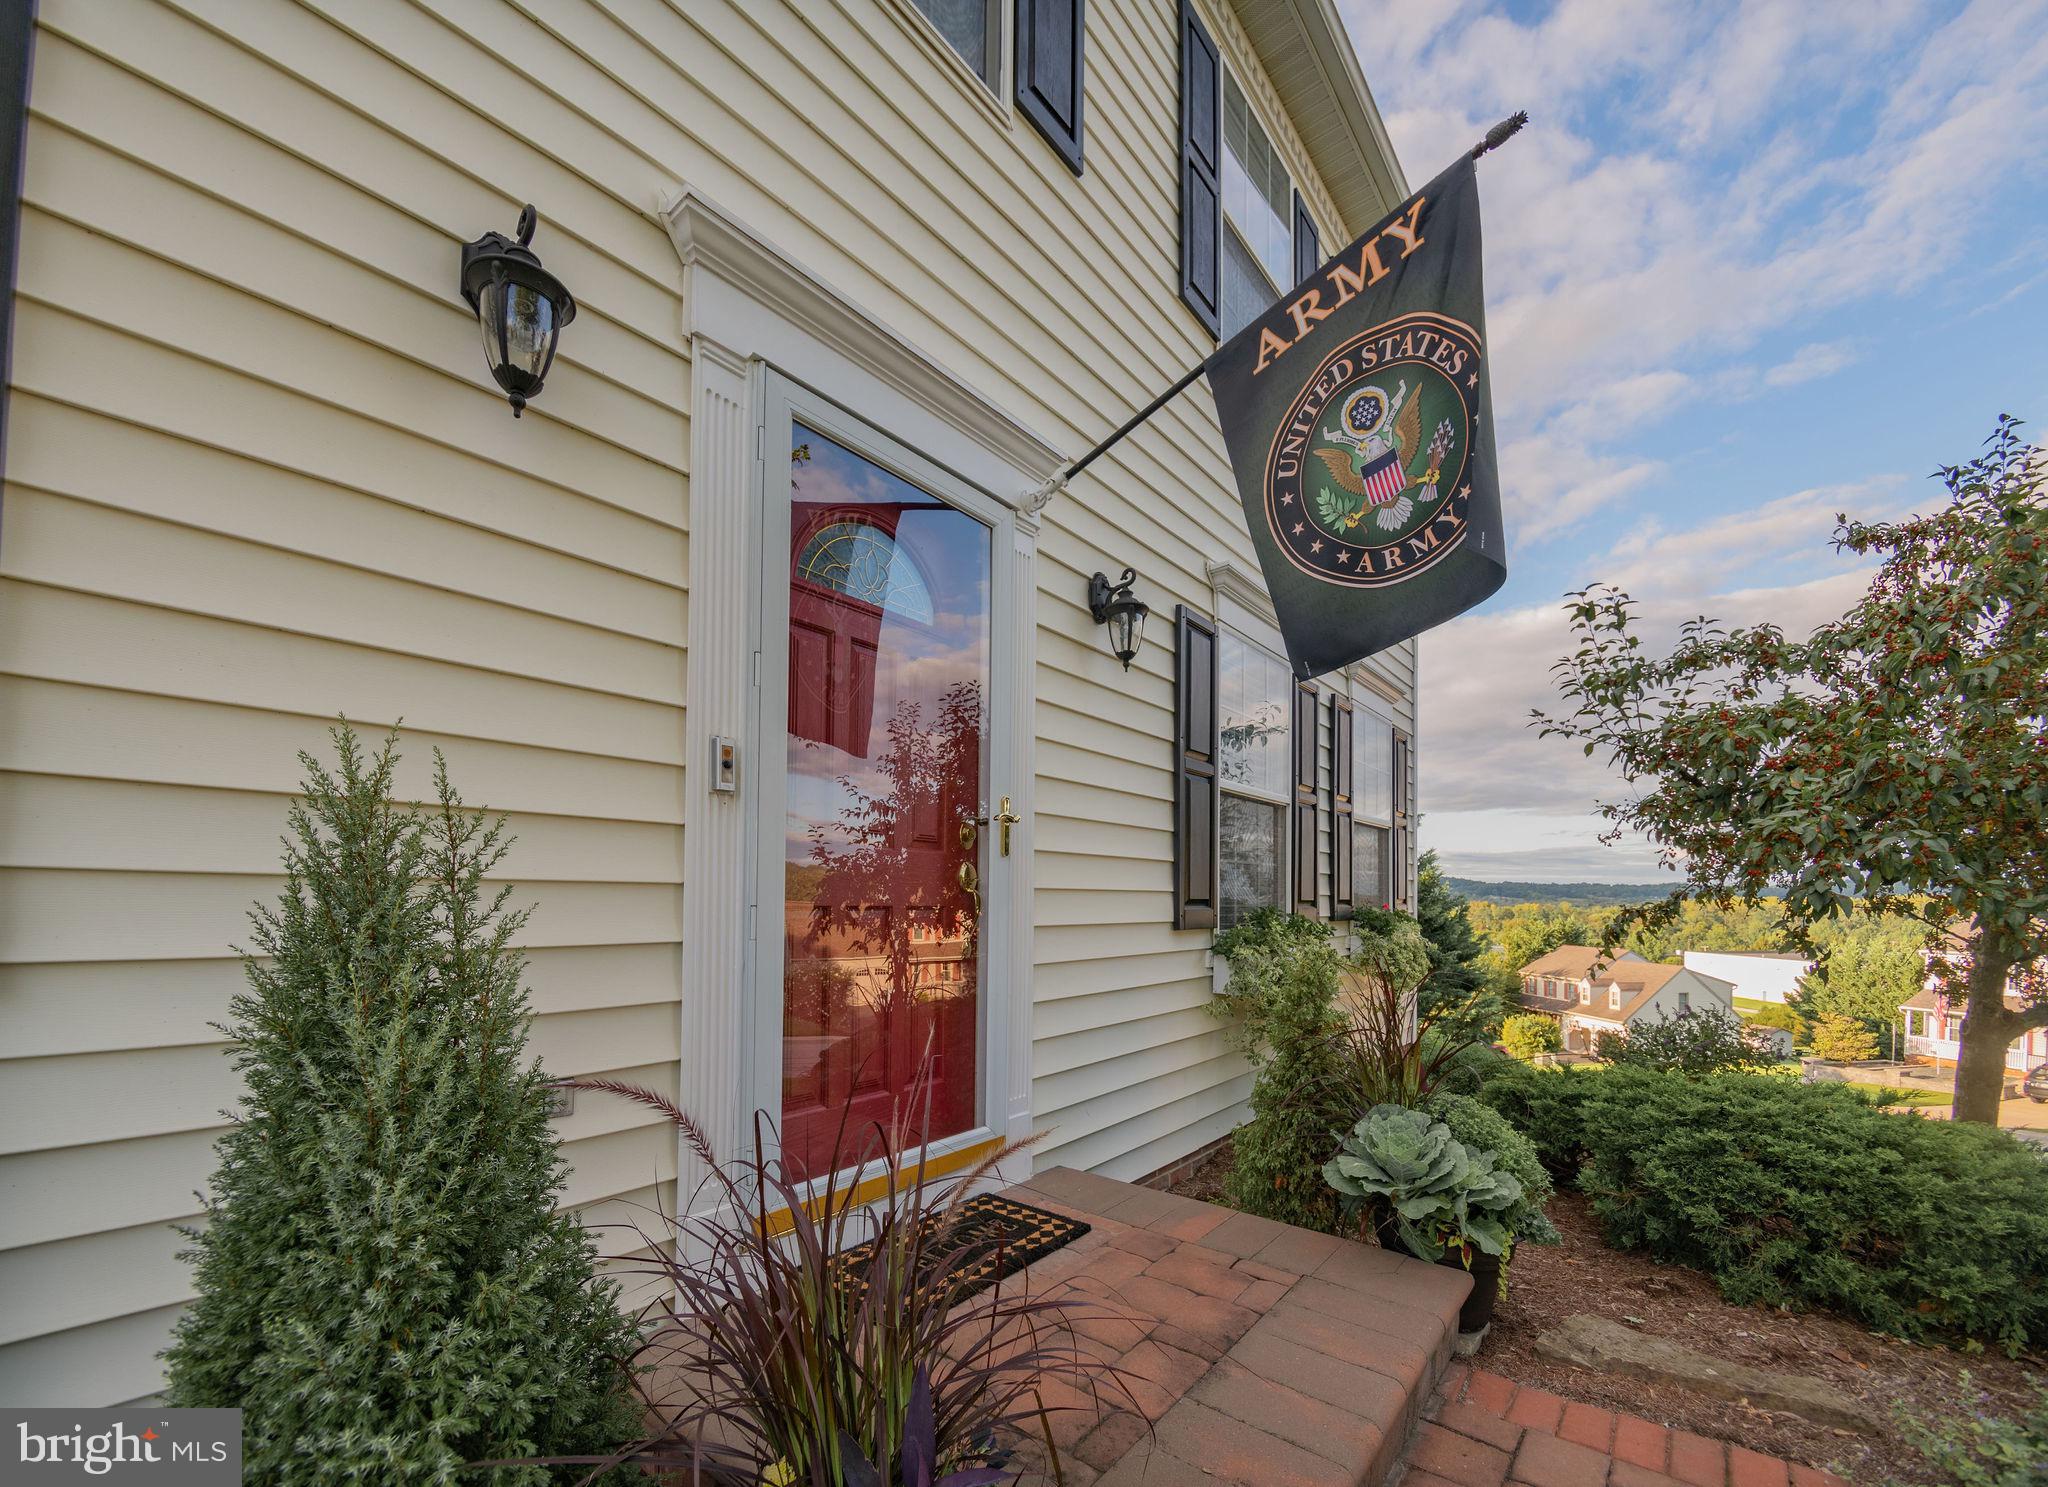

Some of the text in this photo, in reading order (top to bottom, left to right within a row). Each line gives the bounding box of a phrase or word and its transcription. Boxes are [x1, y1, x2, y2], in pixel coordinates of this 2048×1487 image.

[1252, 196, 1426, 376] ARMY
[1277, 330, 1469, 480] UNITED STATES
[1354, 502, 1463, 574] ARMY
